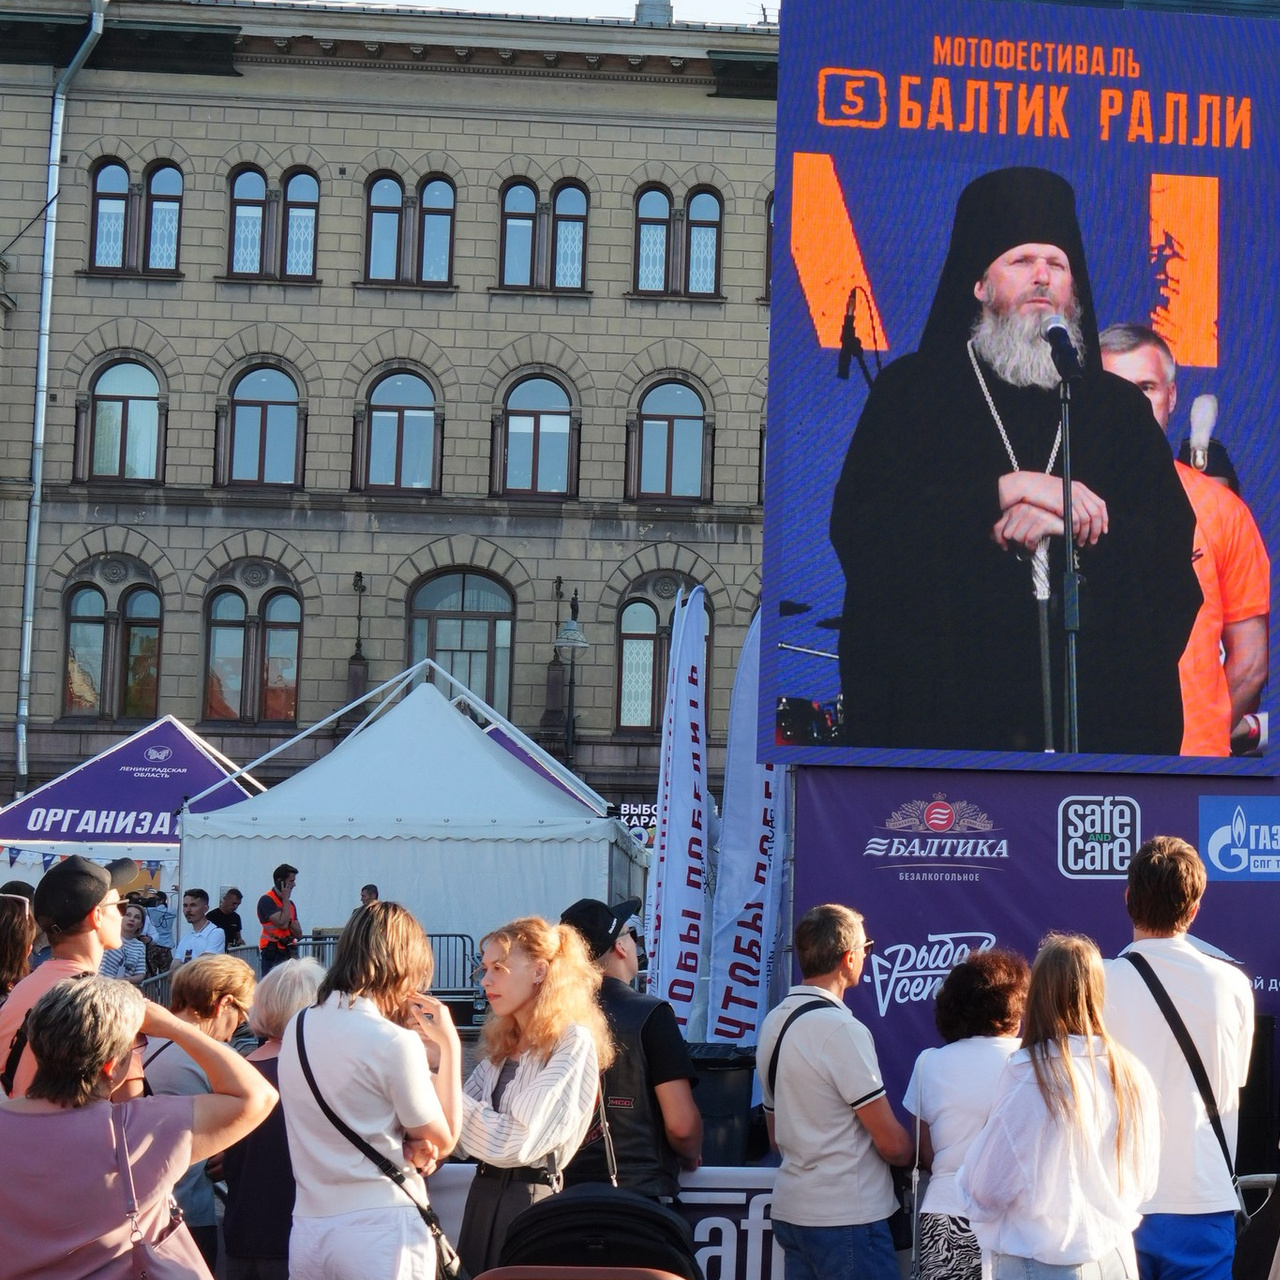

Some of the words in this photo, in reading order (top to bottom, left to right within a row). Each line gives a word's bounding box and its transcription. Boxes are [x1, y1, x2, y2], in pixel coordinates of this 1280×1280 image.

[933, 35, 1140, 79] МОТОФЕСТИВАЛЬ
[841, 79, 866, 115] 5
[899, 75, 1070, 139] БАЛТИК
[1099, 89, 1252, 150] РАЛЛИ
[119, 766, 187, 774] ЛЕНИНГРАДСКАЯ
[27, 807, 179, 836] ОРГАНИЗА
[1067, 796, 1131, 837] safe
[1088, 833, 1112, 842] AND
[888, 838, 1010, 858] БАЛТИКА
[1253, 859, 1274, 869] СПГ
[899, 872, 980, 882] БЕЗАЛКОГОЛЬНОЕ
